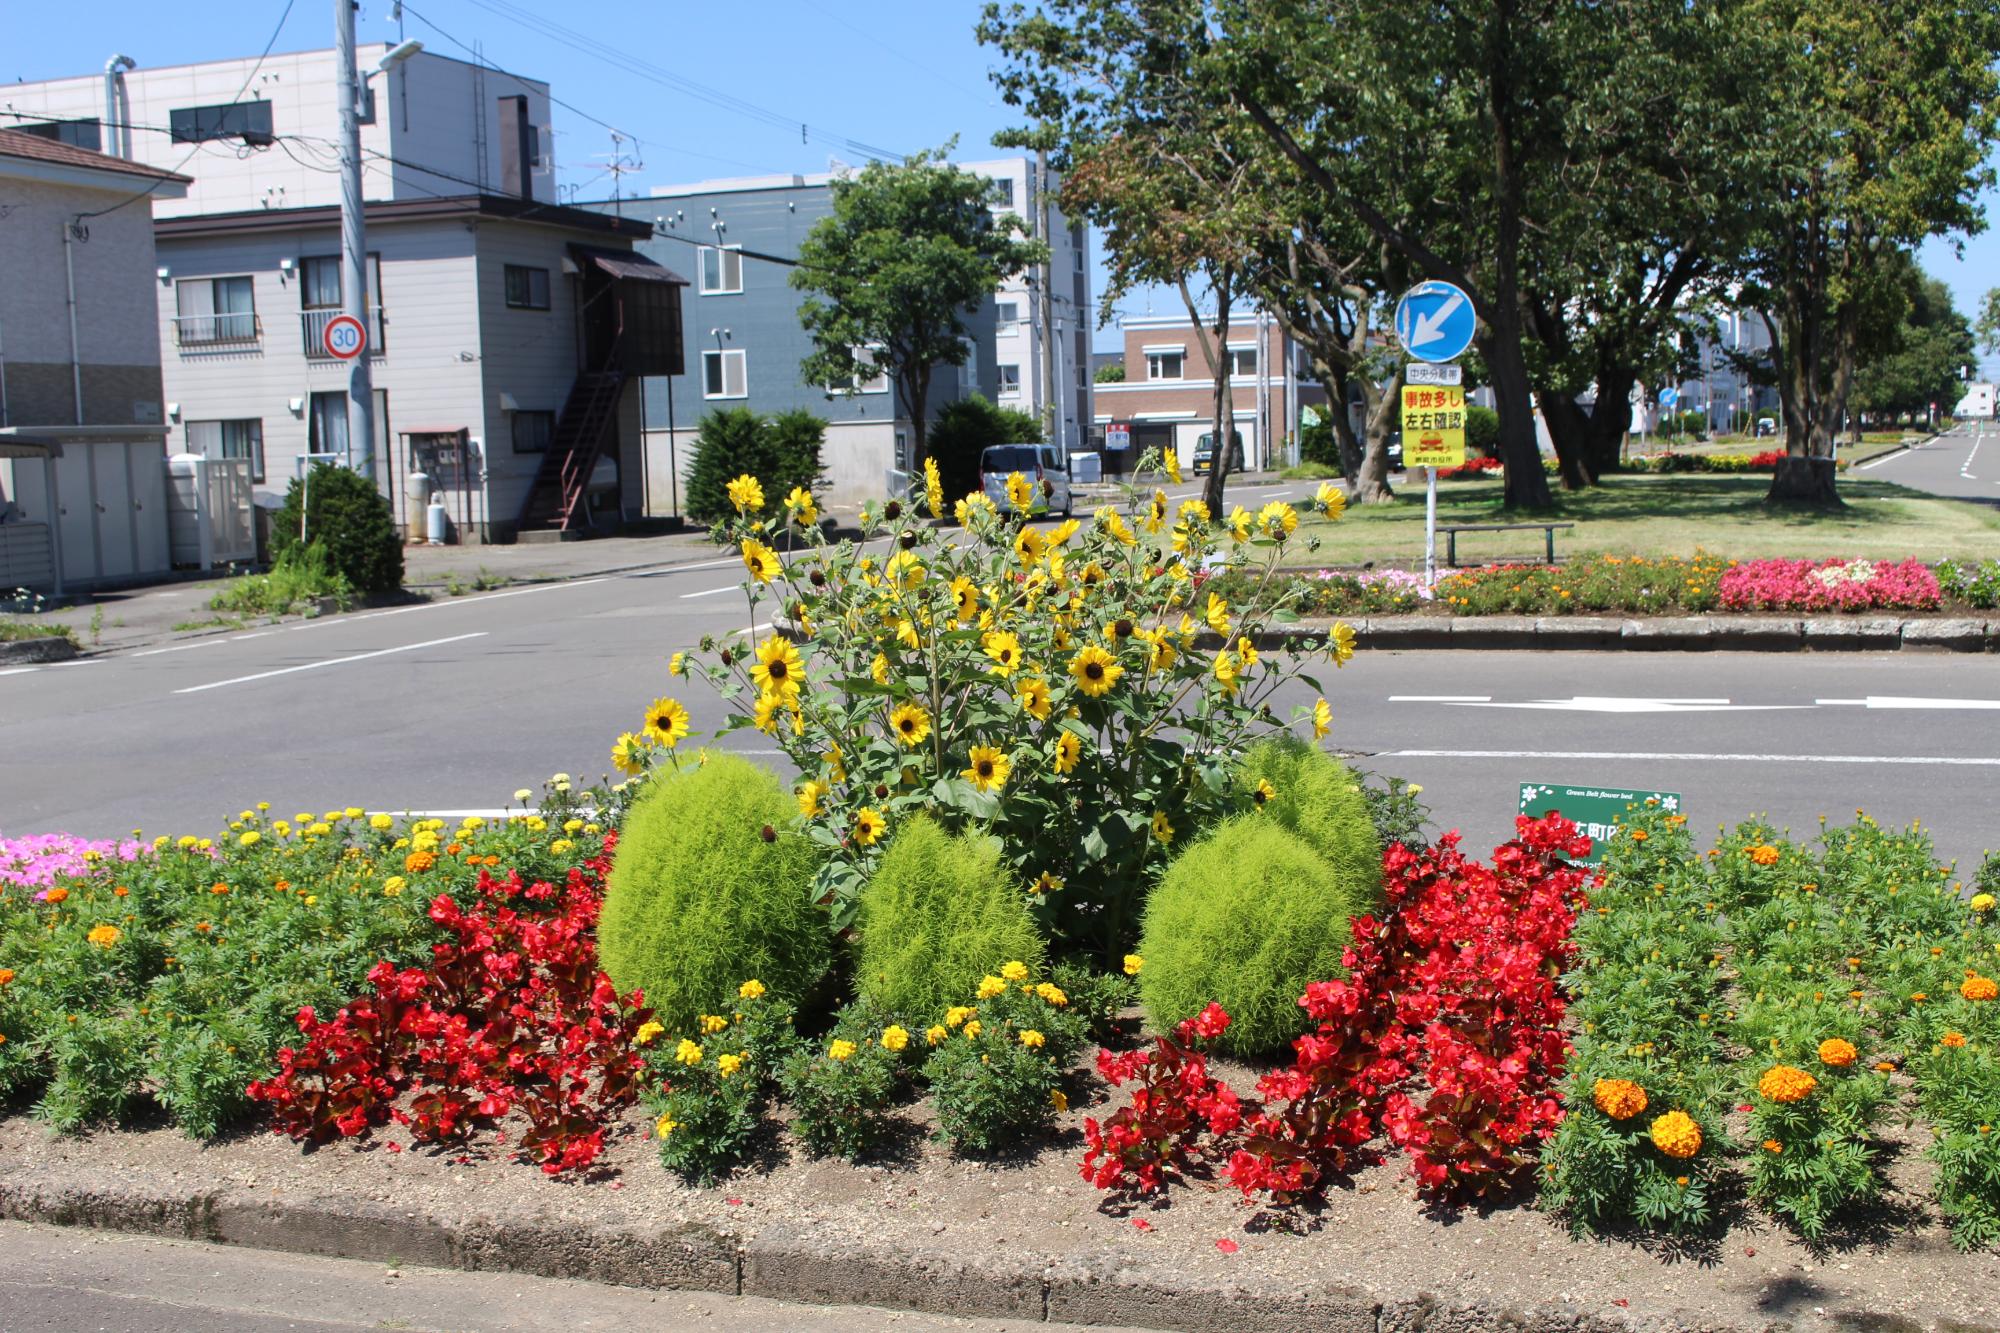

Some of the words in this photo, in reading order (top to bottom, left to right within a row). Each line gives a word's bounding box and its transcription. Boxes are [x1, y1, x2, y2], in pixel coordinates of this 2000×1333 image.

[333, 328, 356, 348] 30
[1405, 390, 1461, 409] 事故多し
[1405, 411, 1462, 430] 左右確認
[1599, 791, 1620, 799] flower
